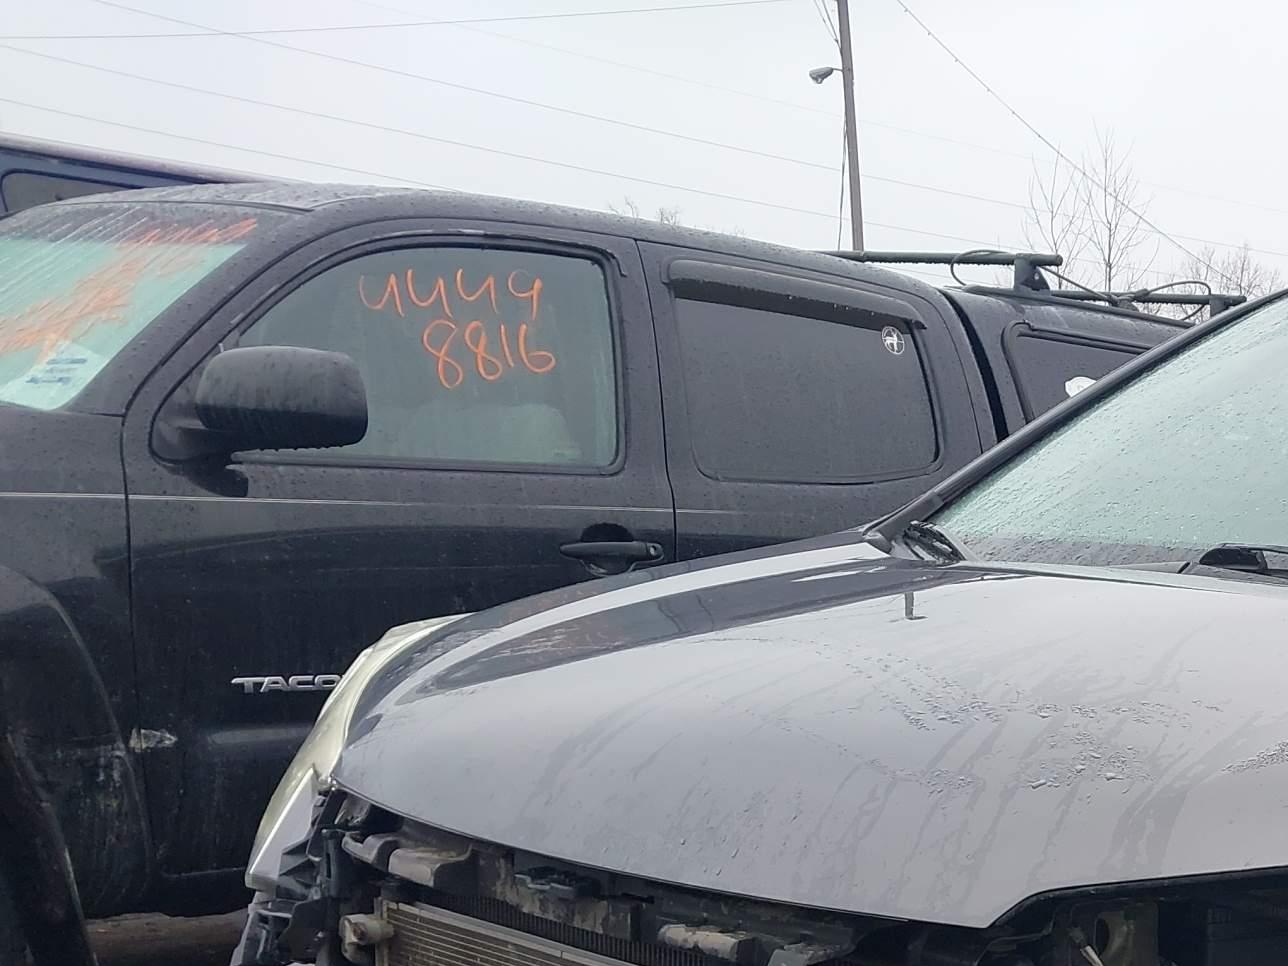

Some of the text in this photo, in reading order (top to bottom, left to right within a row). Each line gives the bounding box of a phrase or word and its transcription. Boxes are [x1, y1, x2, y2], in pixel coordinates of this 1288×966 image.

[359, 268, 543, 320] 4449
[422, 319, 556, 389] 8816
[231, 674, 345, 693] TACO
